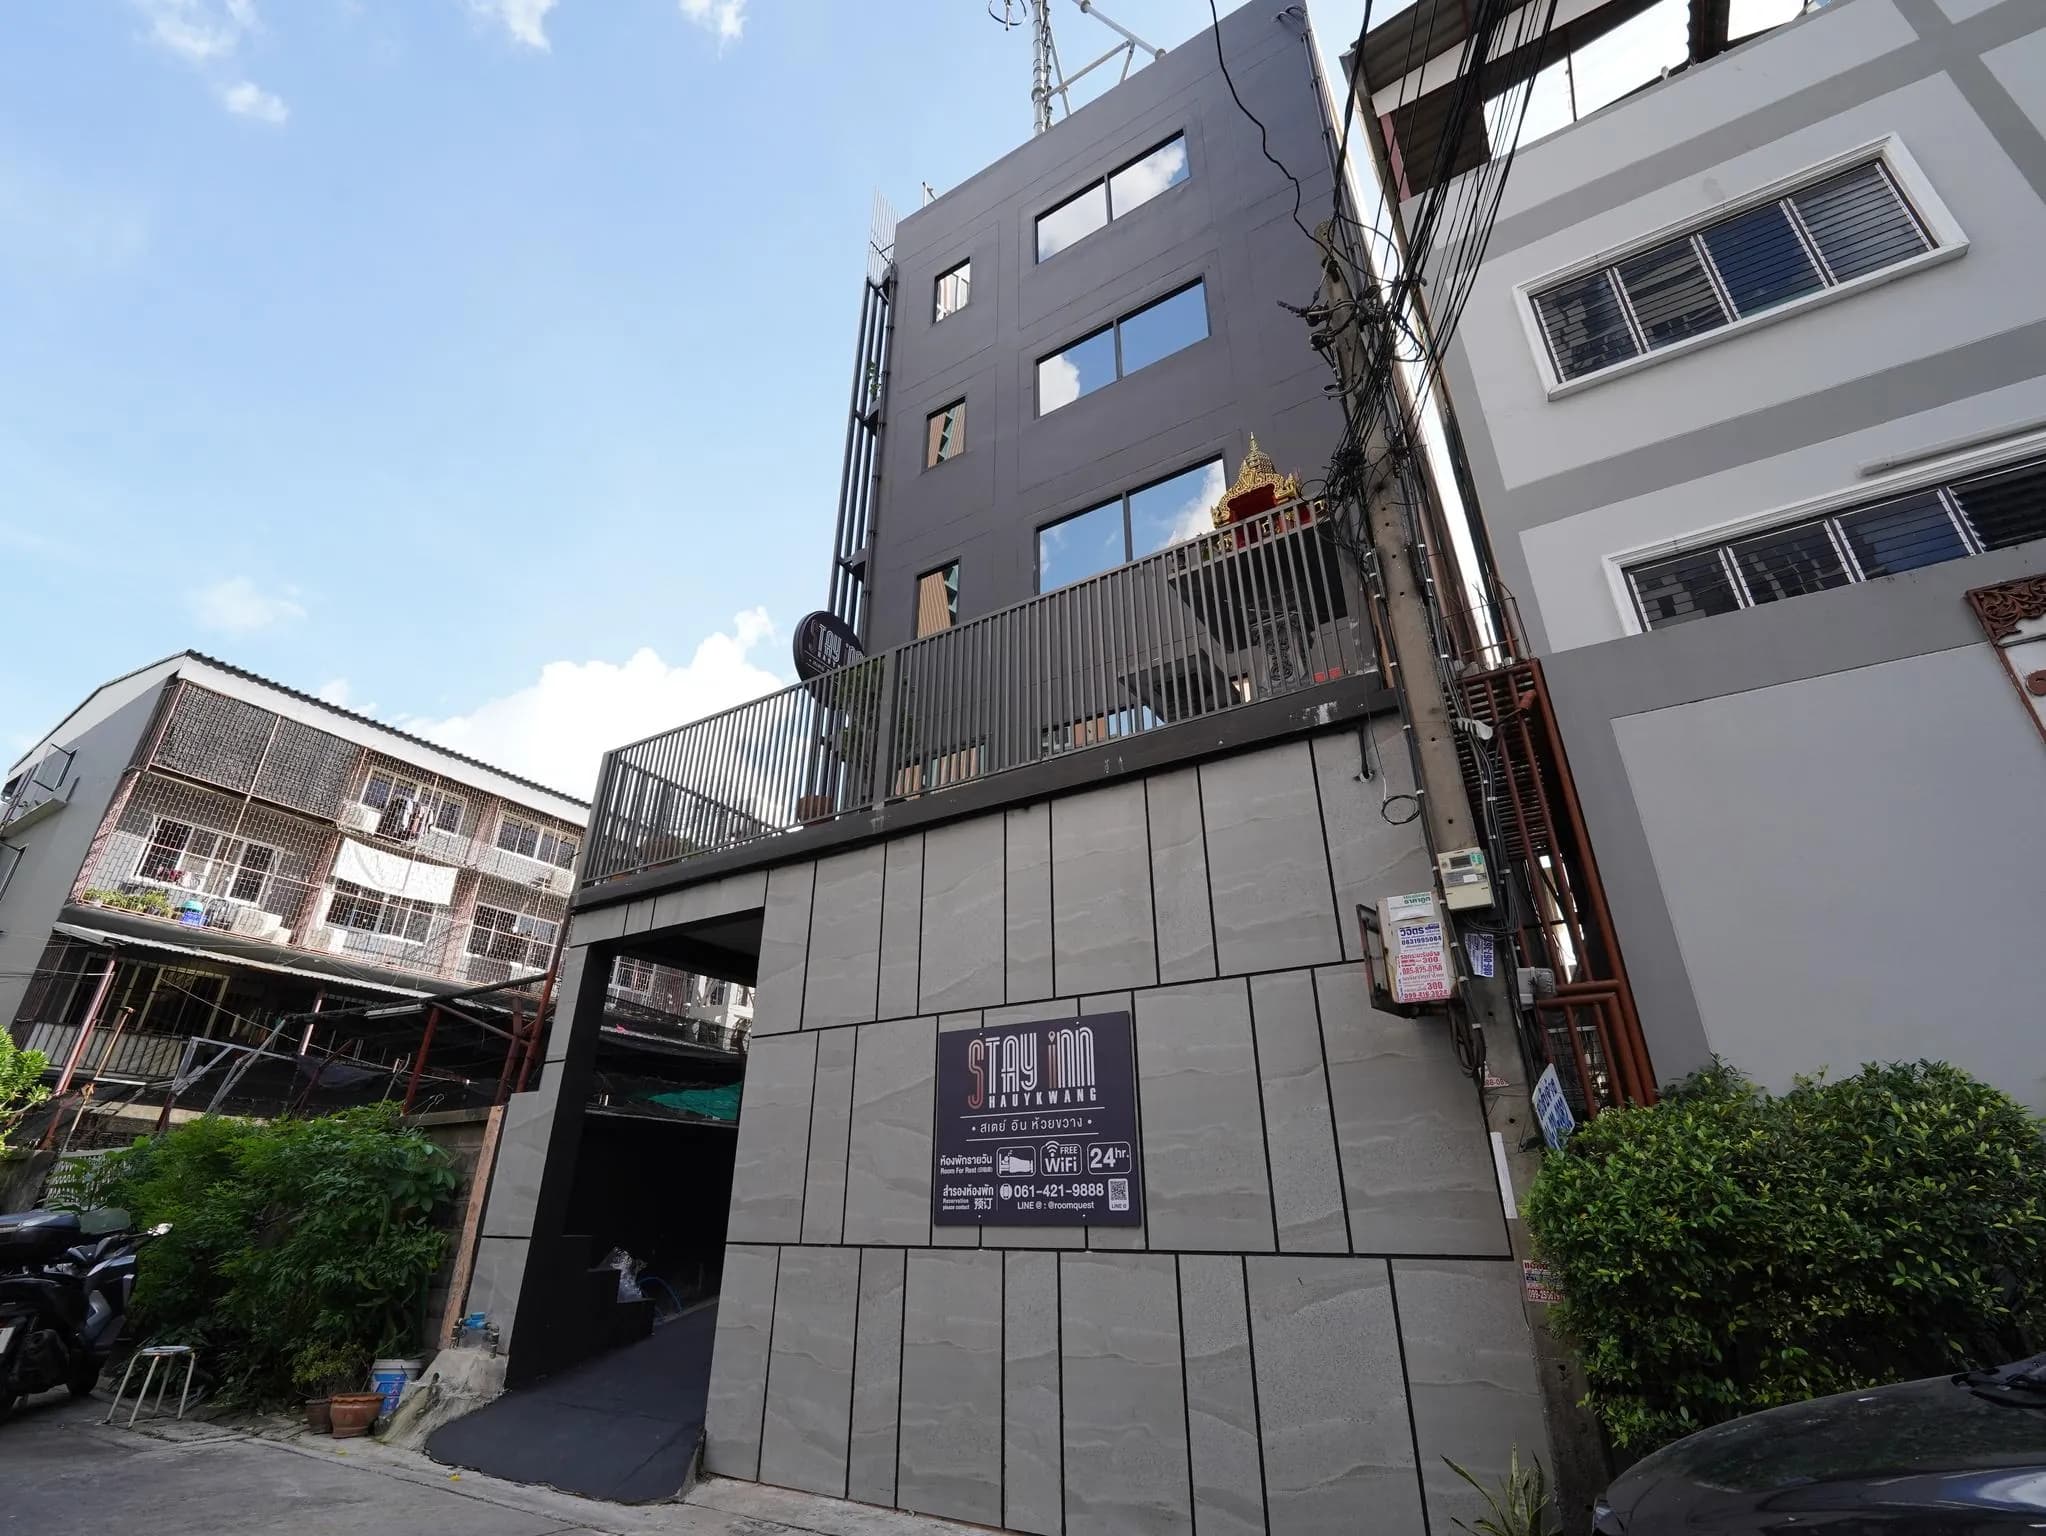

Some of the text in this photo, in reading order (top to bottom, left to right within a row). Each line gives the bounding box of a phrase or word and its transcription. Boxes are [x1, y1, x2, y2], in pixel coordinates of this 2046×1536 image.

[988, 1087, 1097, 1109] HAUYKWANG
[1011, 1119, 1027, 1131] อิน
[1031, 1116, 1083, 1130] ห้วยขวาง
[1060, 1146, 1078, 1155] FREE
[940, 1153, 993, 1166] ห้องพักรายวัน
[1045, 1156, 1078, 1173] WiFi
[943, 1184, 994, 1197] สำรองห้องพัก
[1014, 1183, 1105, 1198] 061-421-9888
[1017, 1201, 1034, 1210] LINE
[1048, 1200, 1095, 1211] @roomquest
